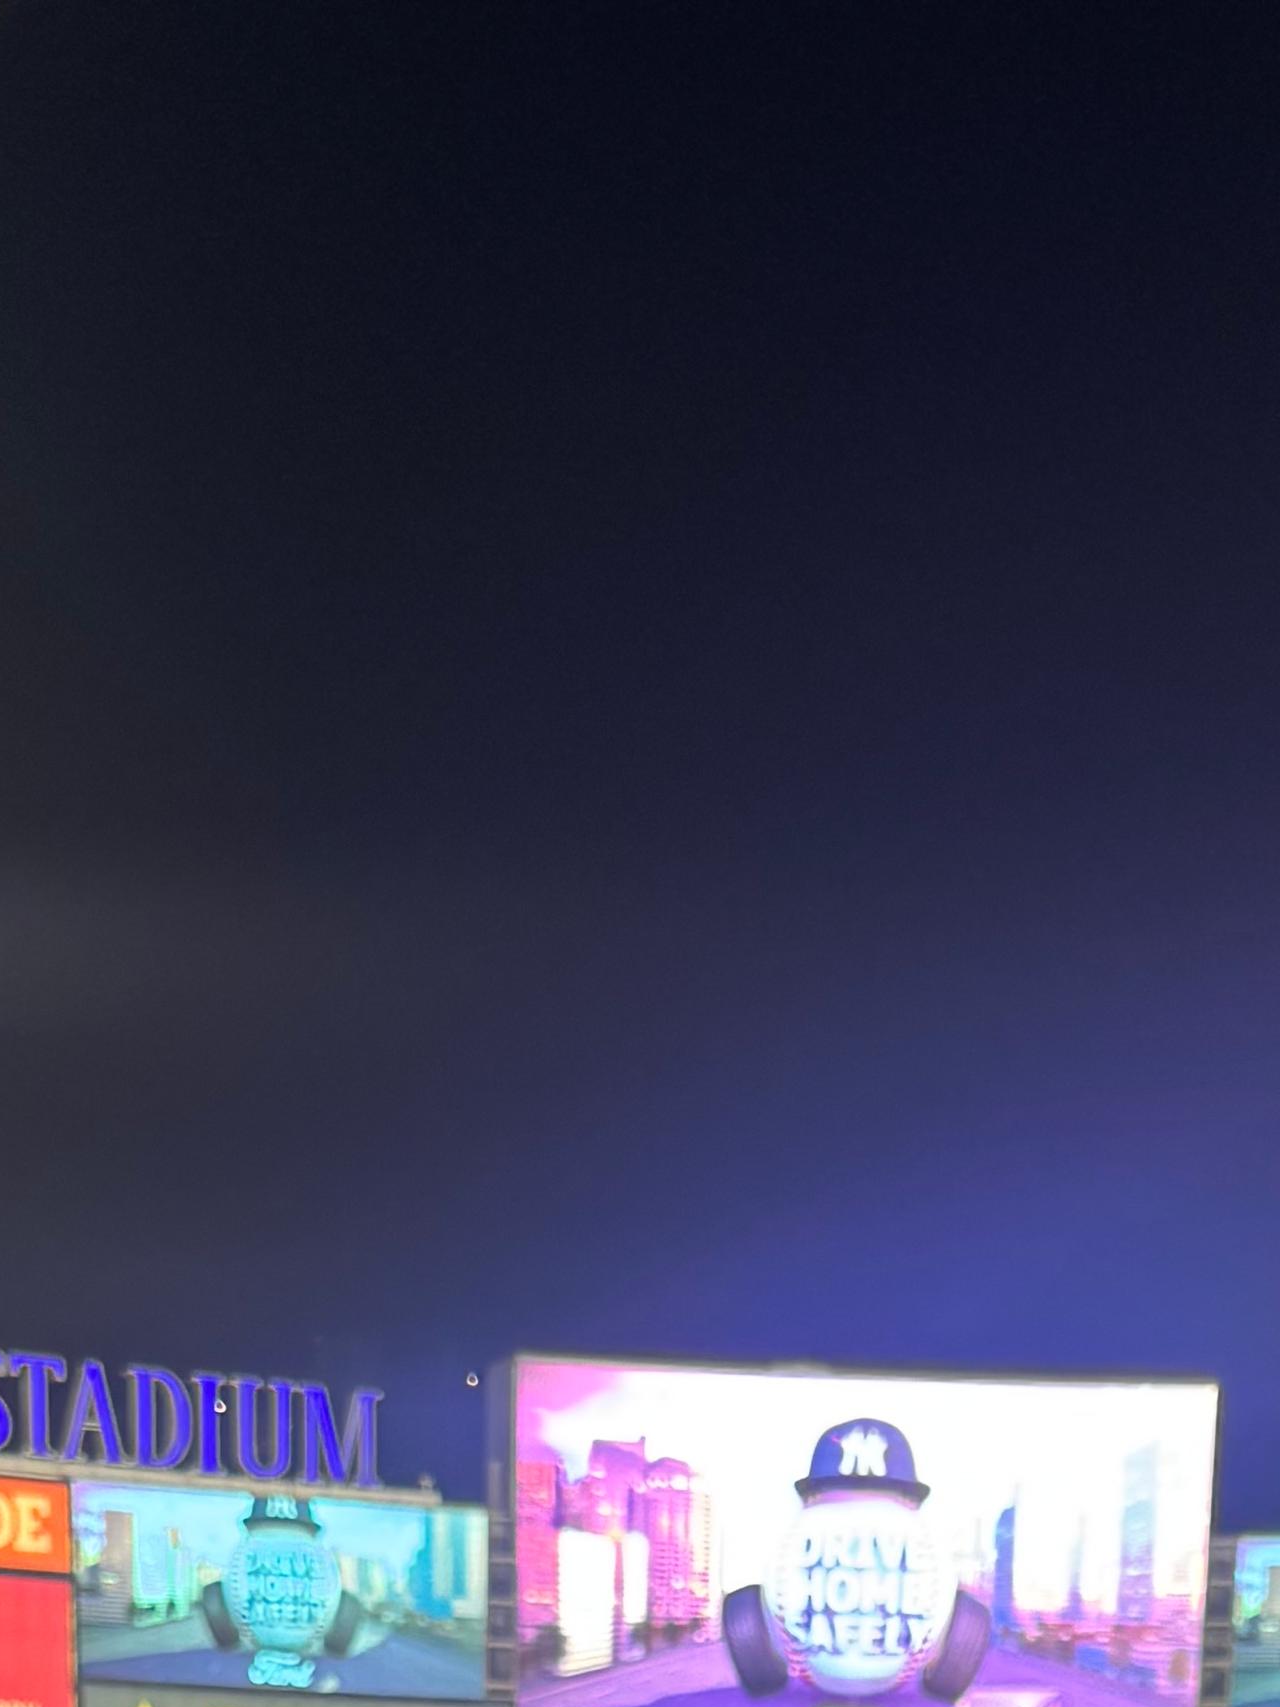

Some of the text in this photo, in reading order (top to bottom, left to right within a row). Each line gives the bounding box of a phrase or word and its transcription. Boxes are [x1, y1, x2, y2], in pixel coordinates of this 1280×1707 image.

[797, 1527, 926, 1571] DRIVE
[796, 1569, 930, 1614] HOME
[784, 1612, 932, 1657] SAFELY
